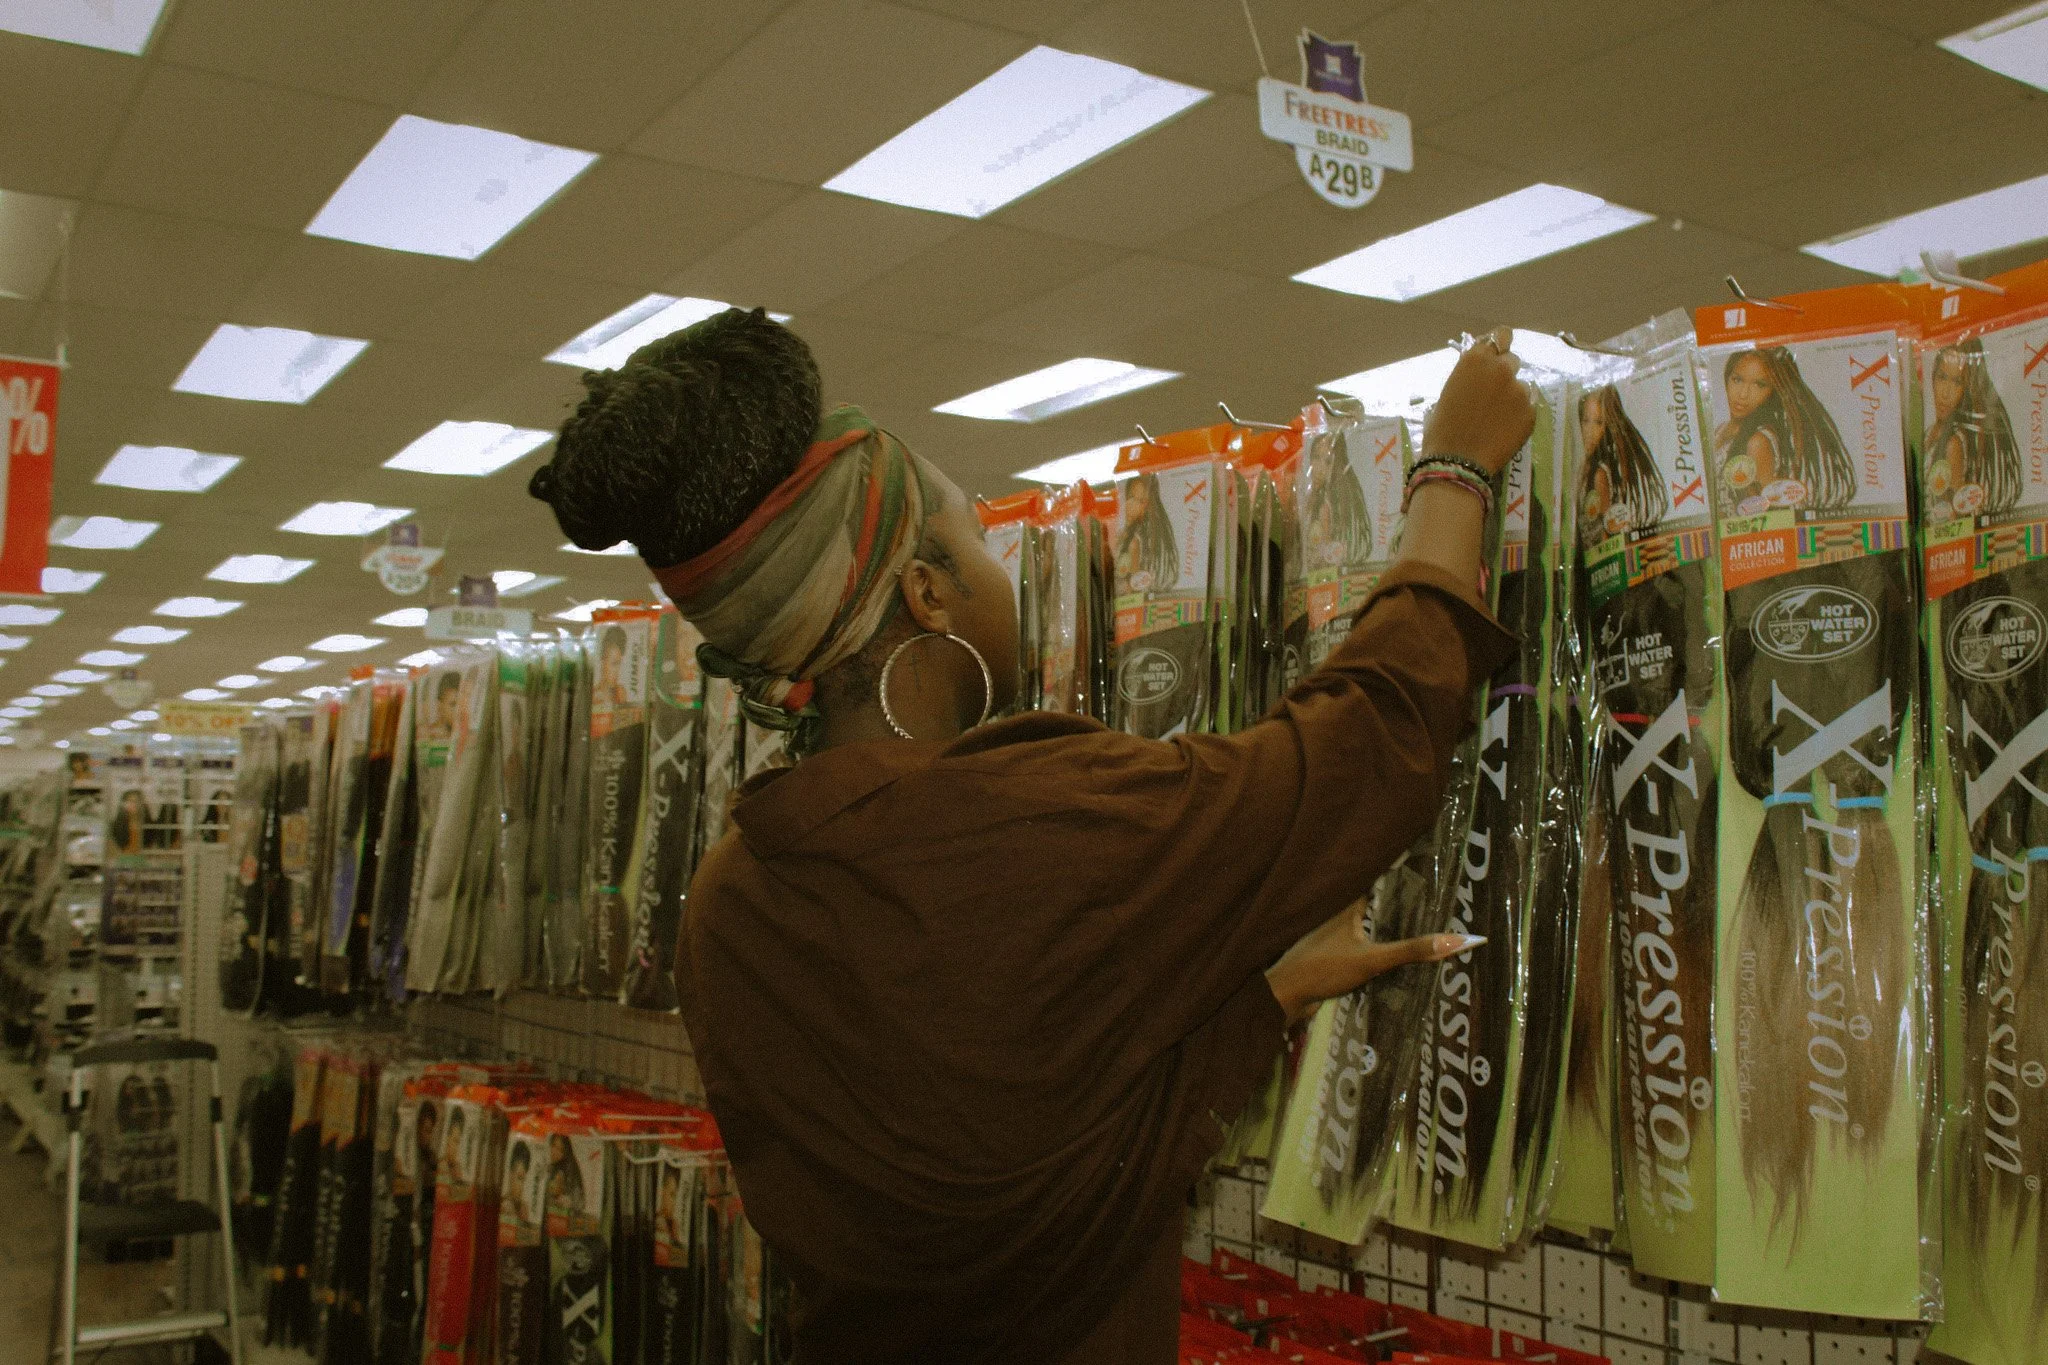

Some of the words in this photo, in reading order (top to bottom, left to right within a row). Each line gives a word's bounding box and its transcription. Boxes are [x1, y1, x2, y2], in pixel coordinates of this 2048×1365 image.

[1316, 129, 1369, 155] BRAID
[1729, 538, 1785, 561] AFRICAN
[1929, 549, 1966, 571] AFRICAN
[1820, 604, 1852, 616] HOT
[1809, 616, 1866, 631] WATER
[2000, 616, 2025, 631] HOT
[1635, 632, 1663, 650] HOT
[1822, 630, 1853, 643] SET
[1992, 629, 2036, 646] WATER
[1629, 645, 1673, 666] WATER
[2001, 644, 2025, 660] SET
[1639, 662, 1665, 680] SET
